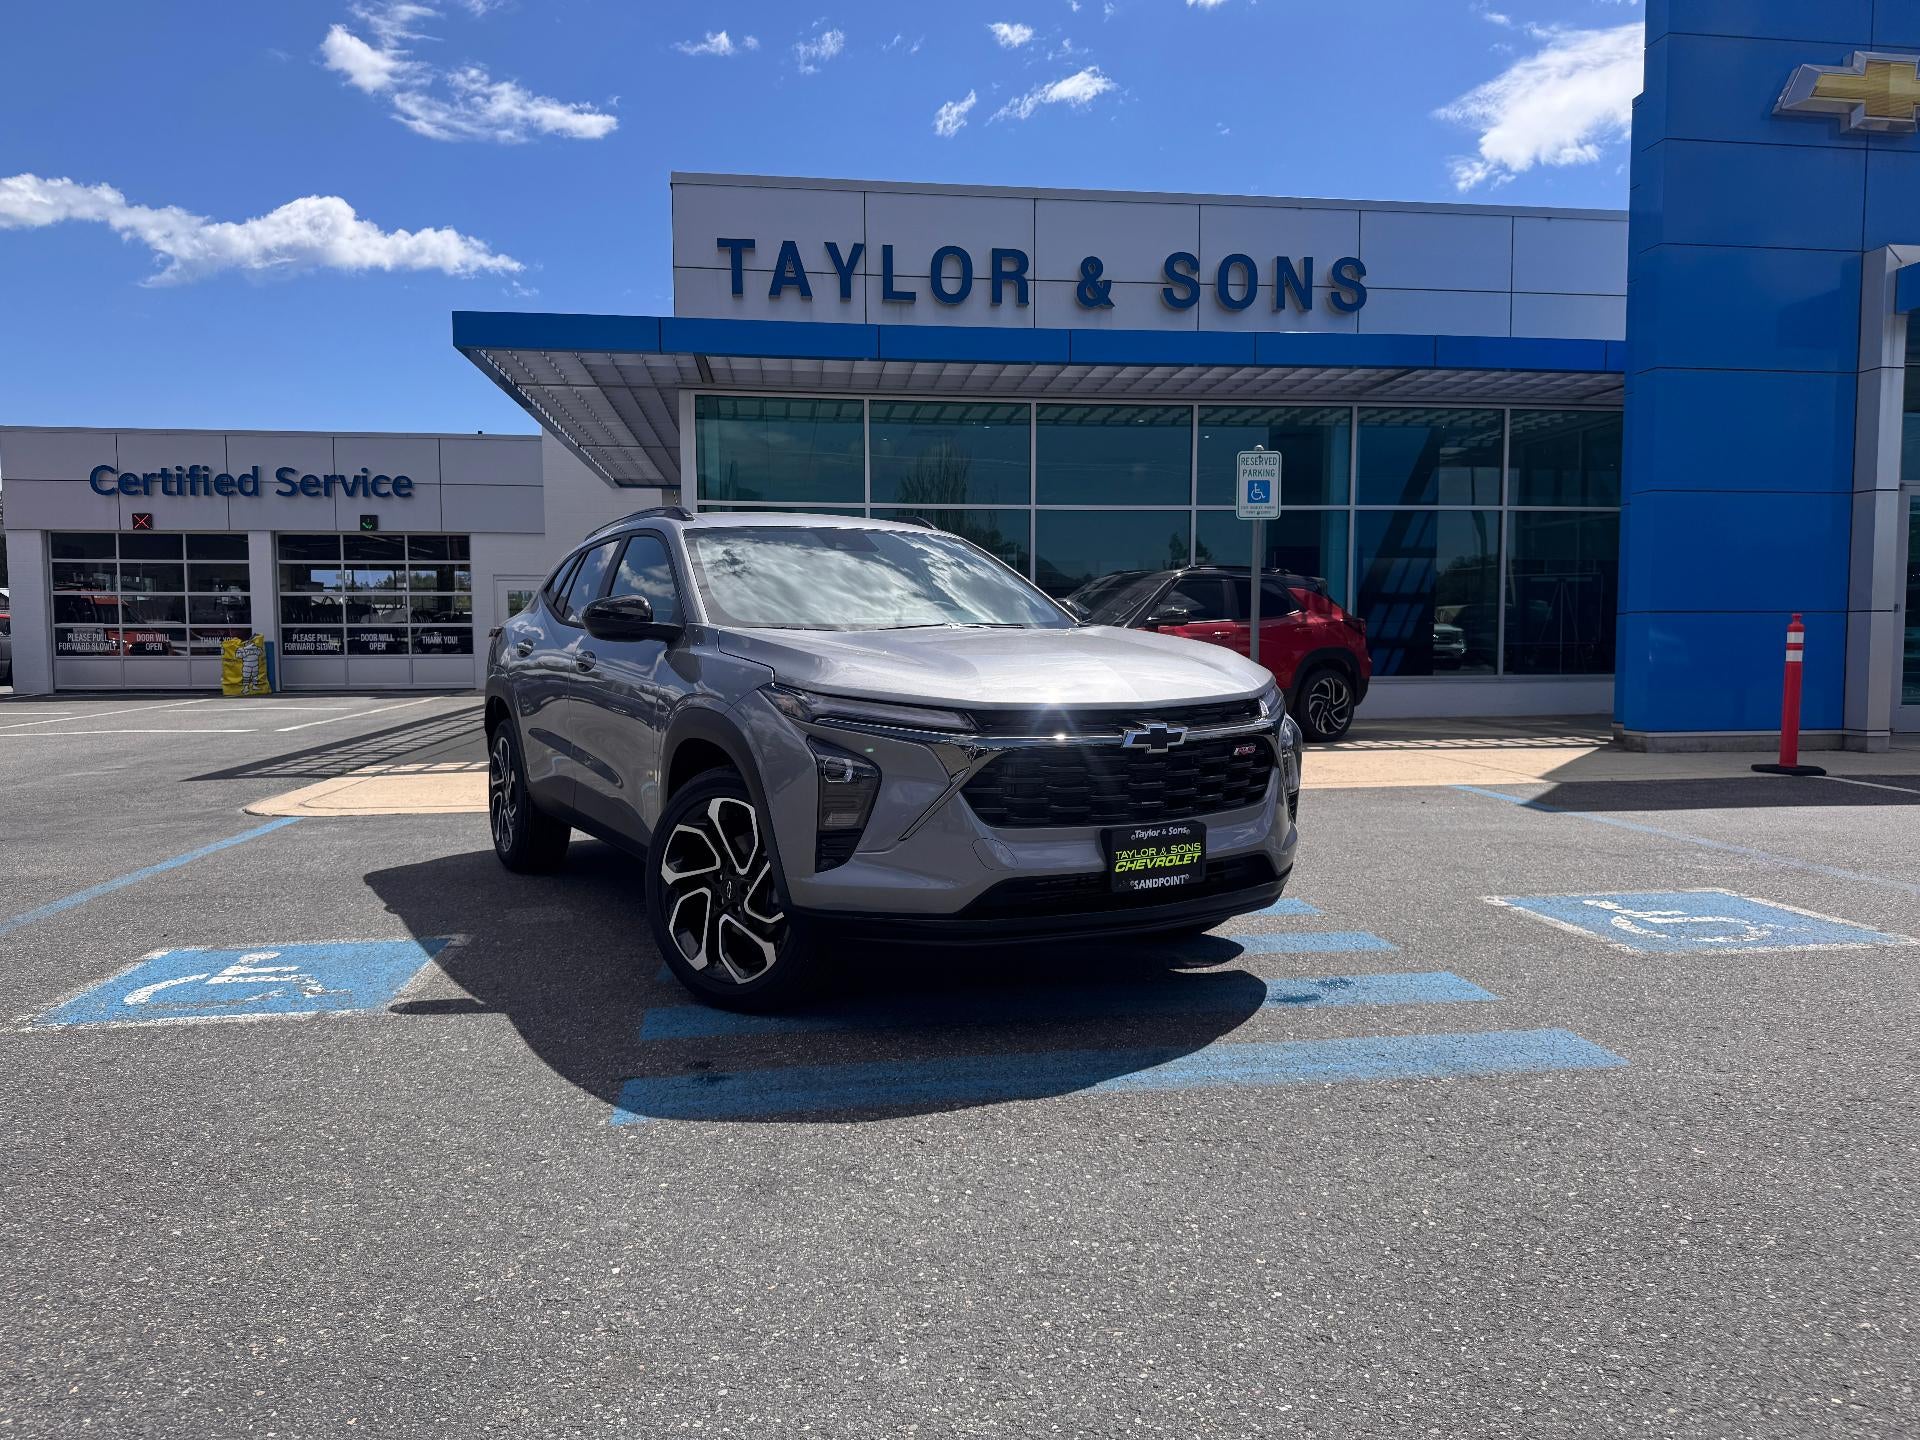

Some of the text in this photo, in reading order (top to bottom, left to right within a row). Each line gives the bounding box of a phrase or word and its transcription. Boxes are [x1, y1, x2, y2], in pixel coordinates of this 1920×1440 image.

[717, 238, 1368, 313] TAYLOR & SONS
[1240, 456, 1278, 466] RESERVED
[1242, 469, 1276, 478] PARKING
[89, 464, 414, 498] Certified Service
[67, 633, 91, 642] PLEASE
[136, 633, 170, 642] DOOR WILL
[292, 633, 332, 642] PLEASE PULL
[360, 633, 394, 642] DOOR WILL
[422, 635, 458, 645] THANK YOU!
[58, 642, 118, 651] FORWARD SLOWLY
[145, 643, 163, 651] OPEN
[284, 642, 341, 651] FORWARD SLOWLY
[369, 643, 386, 651] OPEN
[1134, 828, 1160, 840] Taylor
[1168, 826, 1187, 836] Sons
[1115, 842, 1201, 860] TAYLOR & SONS
[1115, 853, 1201, 873] CHEVROLET
[1133, 874, 1186, 890] SANDPOINT
